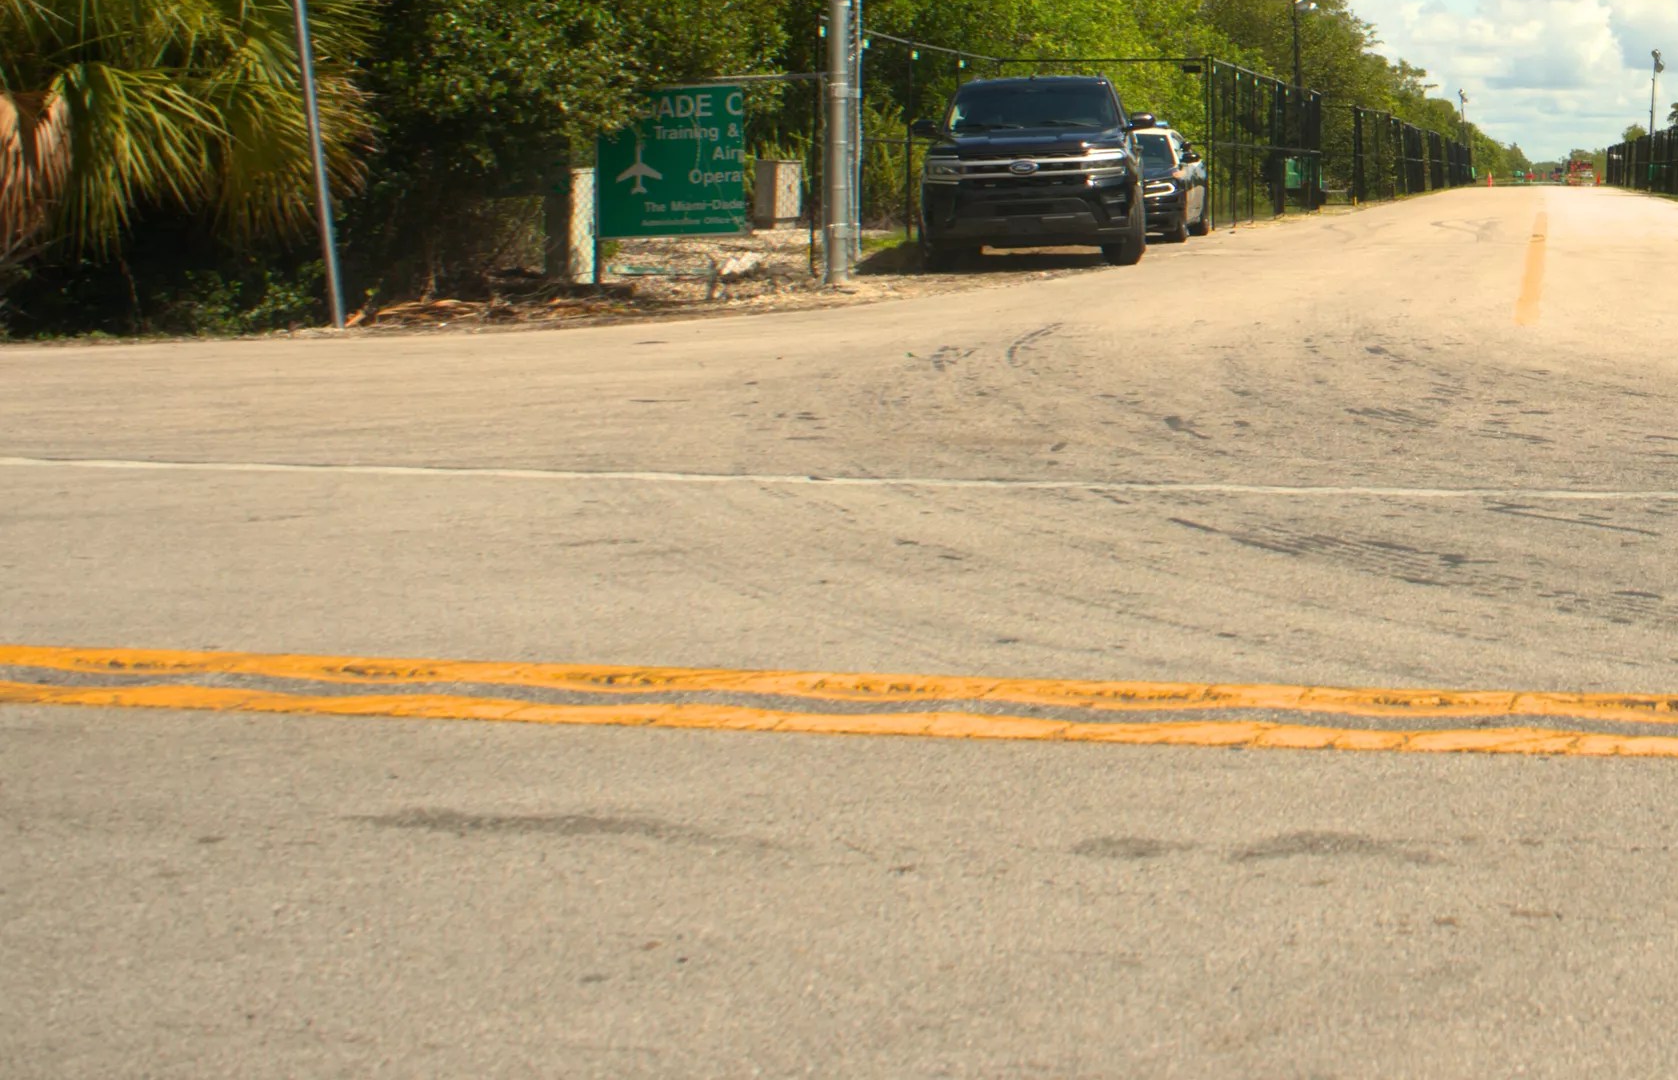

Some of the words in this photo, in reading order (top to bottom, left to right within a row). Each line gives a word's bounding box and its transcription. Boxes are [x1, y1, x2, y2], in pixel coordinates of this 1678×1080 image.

[654, 125, 719, 140] Training
[727, 123, 740, 136] &
[689, 170, 743, 187] Opera
